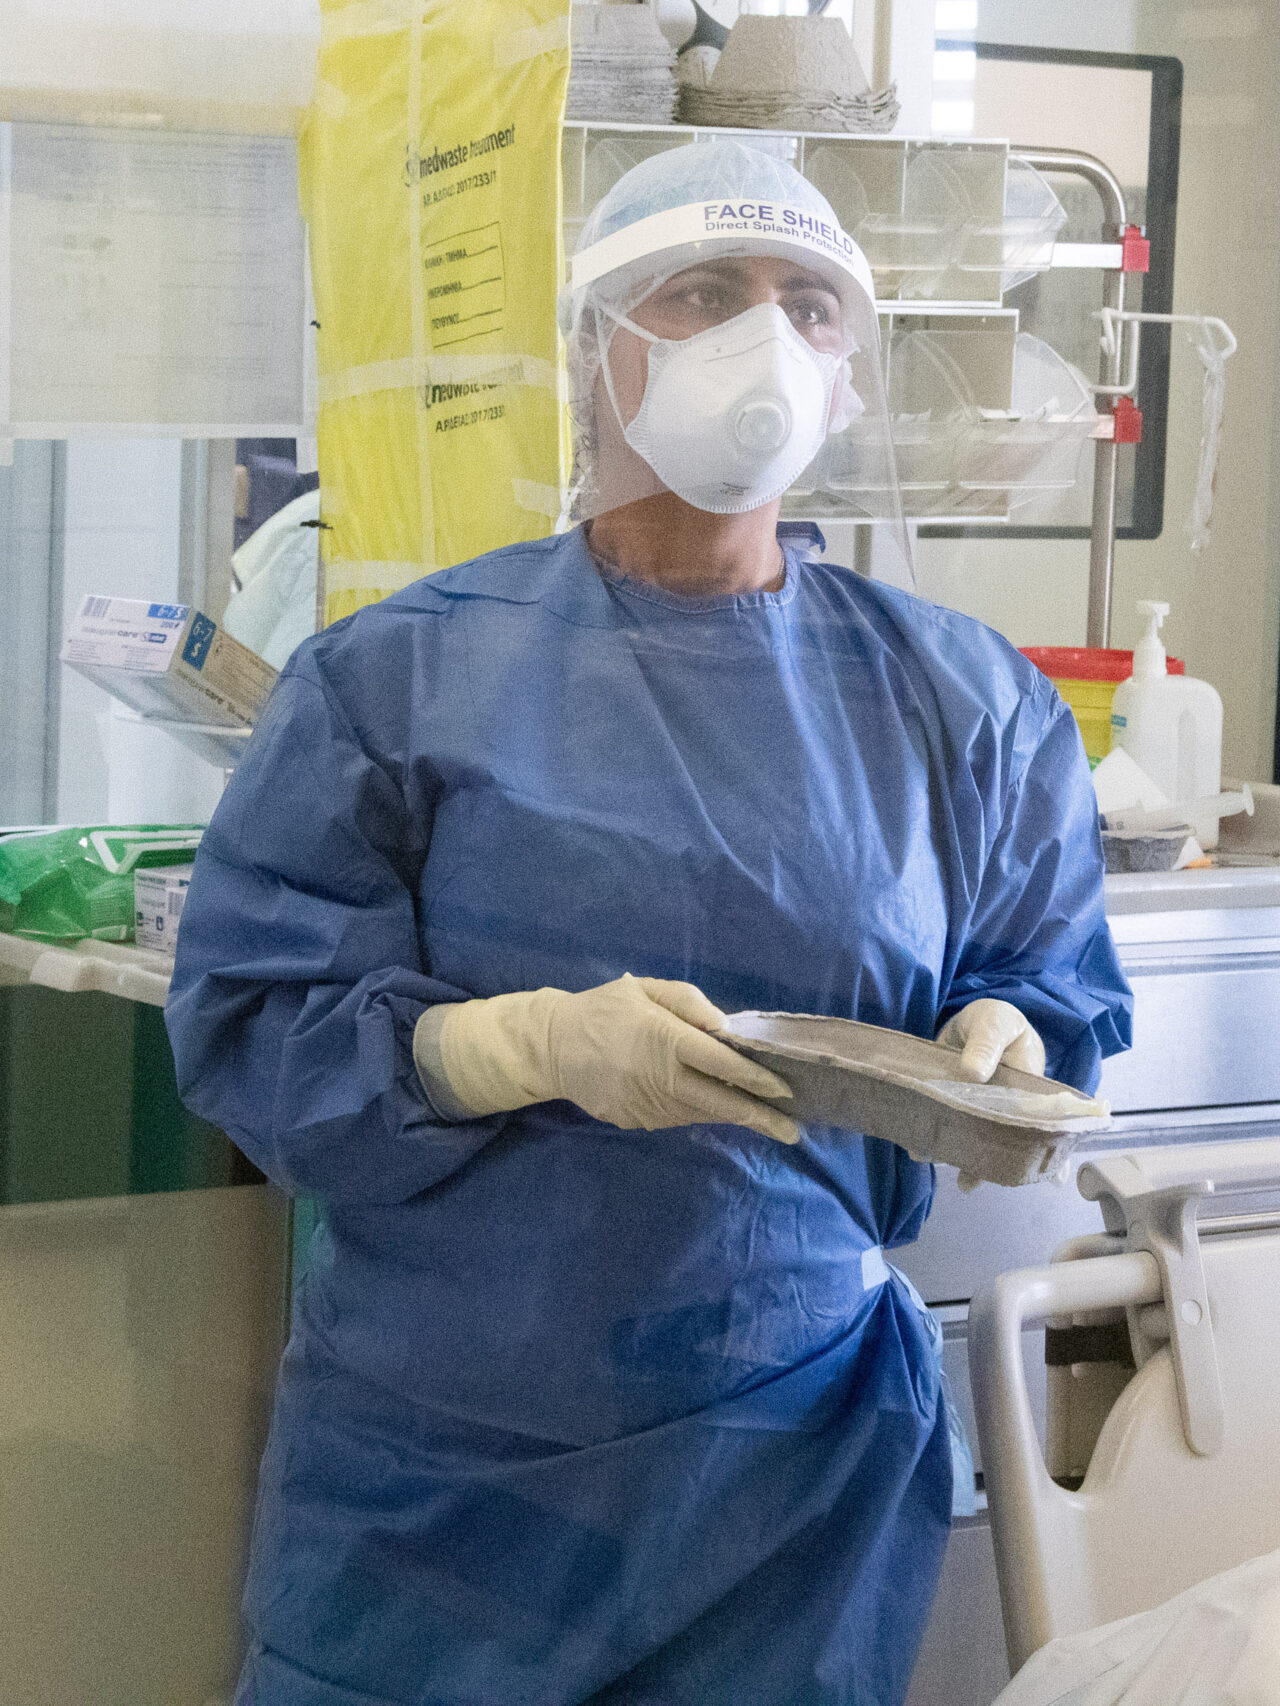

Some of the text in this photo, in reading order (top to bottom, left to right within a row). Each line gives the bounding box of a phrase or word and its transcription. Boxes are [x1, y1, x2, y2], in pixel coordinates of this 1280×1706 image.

[419, 145, 468, 179] medwaste
[704, 204, 853, 255] FACE SHIELD
[705, 221, 854, 265] Direct Splash Protection
